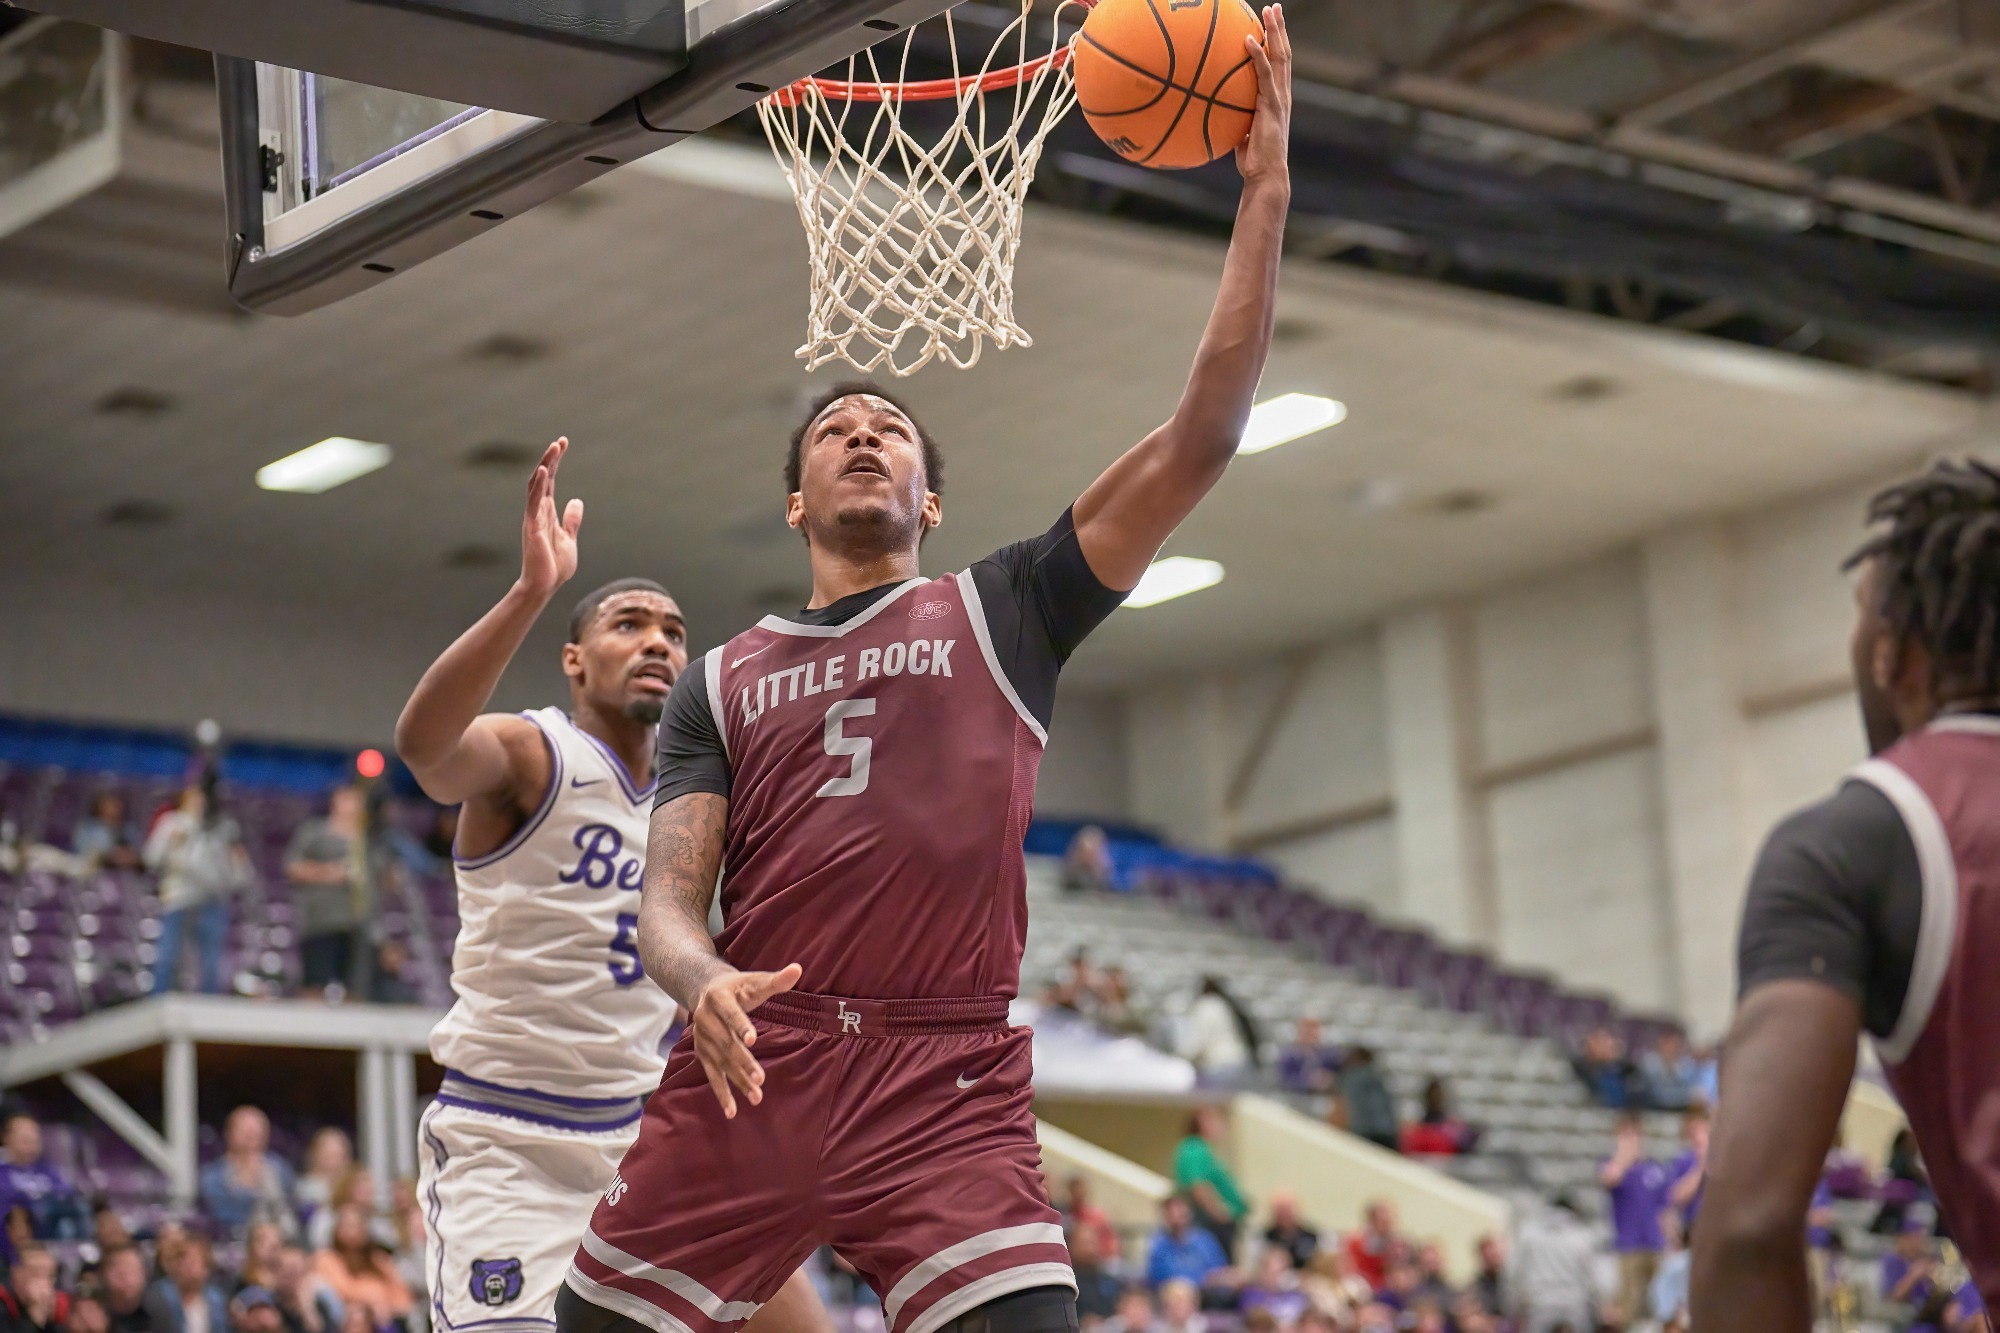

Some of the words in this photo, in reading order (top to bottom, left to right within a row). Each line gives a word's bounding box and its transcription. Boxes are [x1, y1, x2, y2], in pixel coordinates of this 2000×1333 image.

[742, 655, 846, 727] LITTLE
[857, 639, 956, 682] ROCK
[816, 698, 876, 798] 5
[559, 823, 645, 892] Be
[608, 912, 645, 986] 5
[837, 1001, 862, 1034] LR
